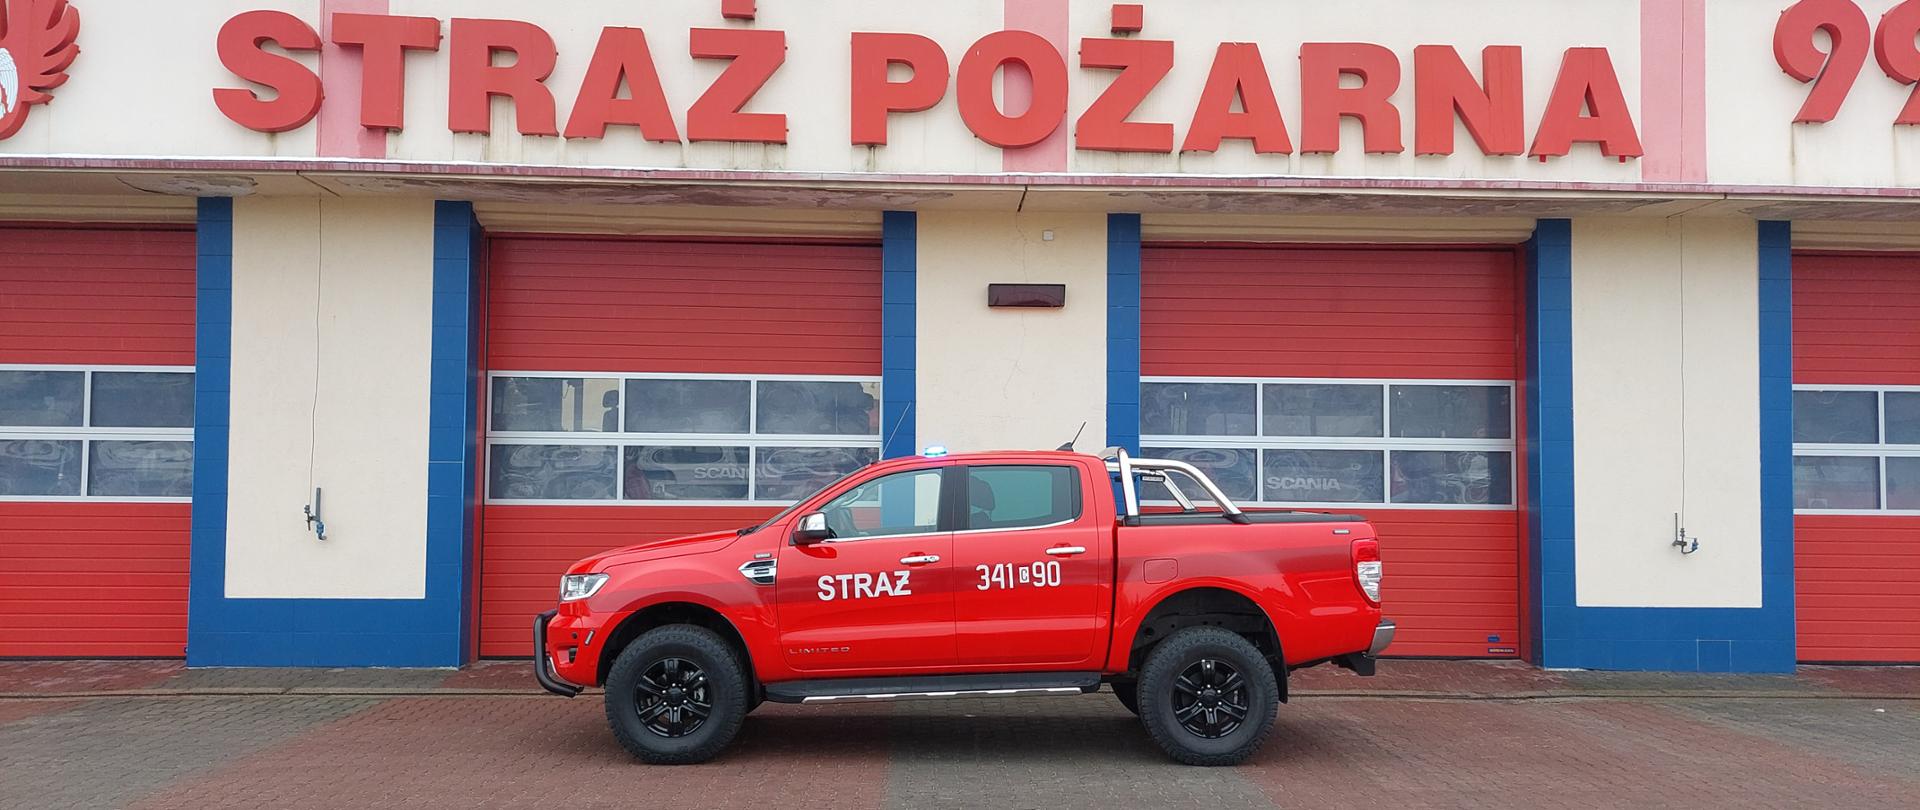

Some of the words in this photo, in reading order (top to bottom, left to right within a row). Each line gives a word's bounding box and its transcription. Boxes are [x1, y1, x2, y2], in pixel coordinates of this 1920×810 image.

[213, 0, 787, 143] STRAŻ
[851, 5, 1643, 160] POŻARNA
[1265, 477, 1341, 490] SCANIA
[789, 646, 850, 654] LIMITED
